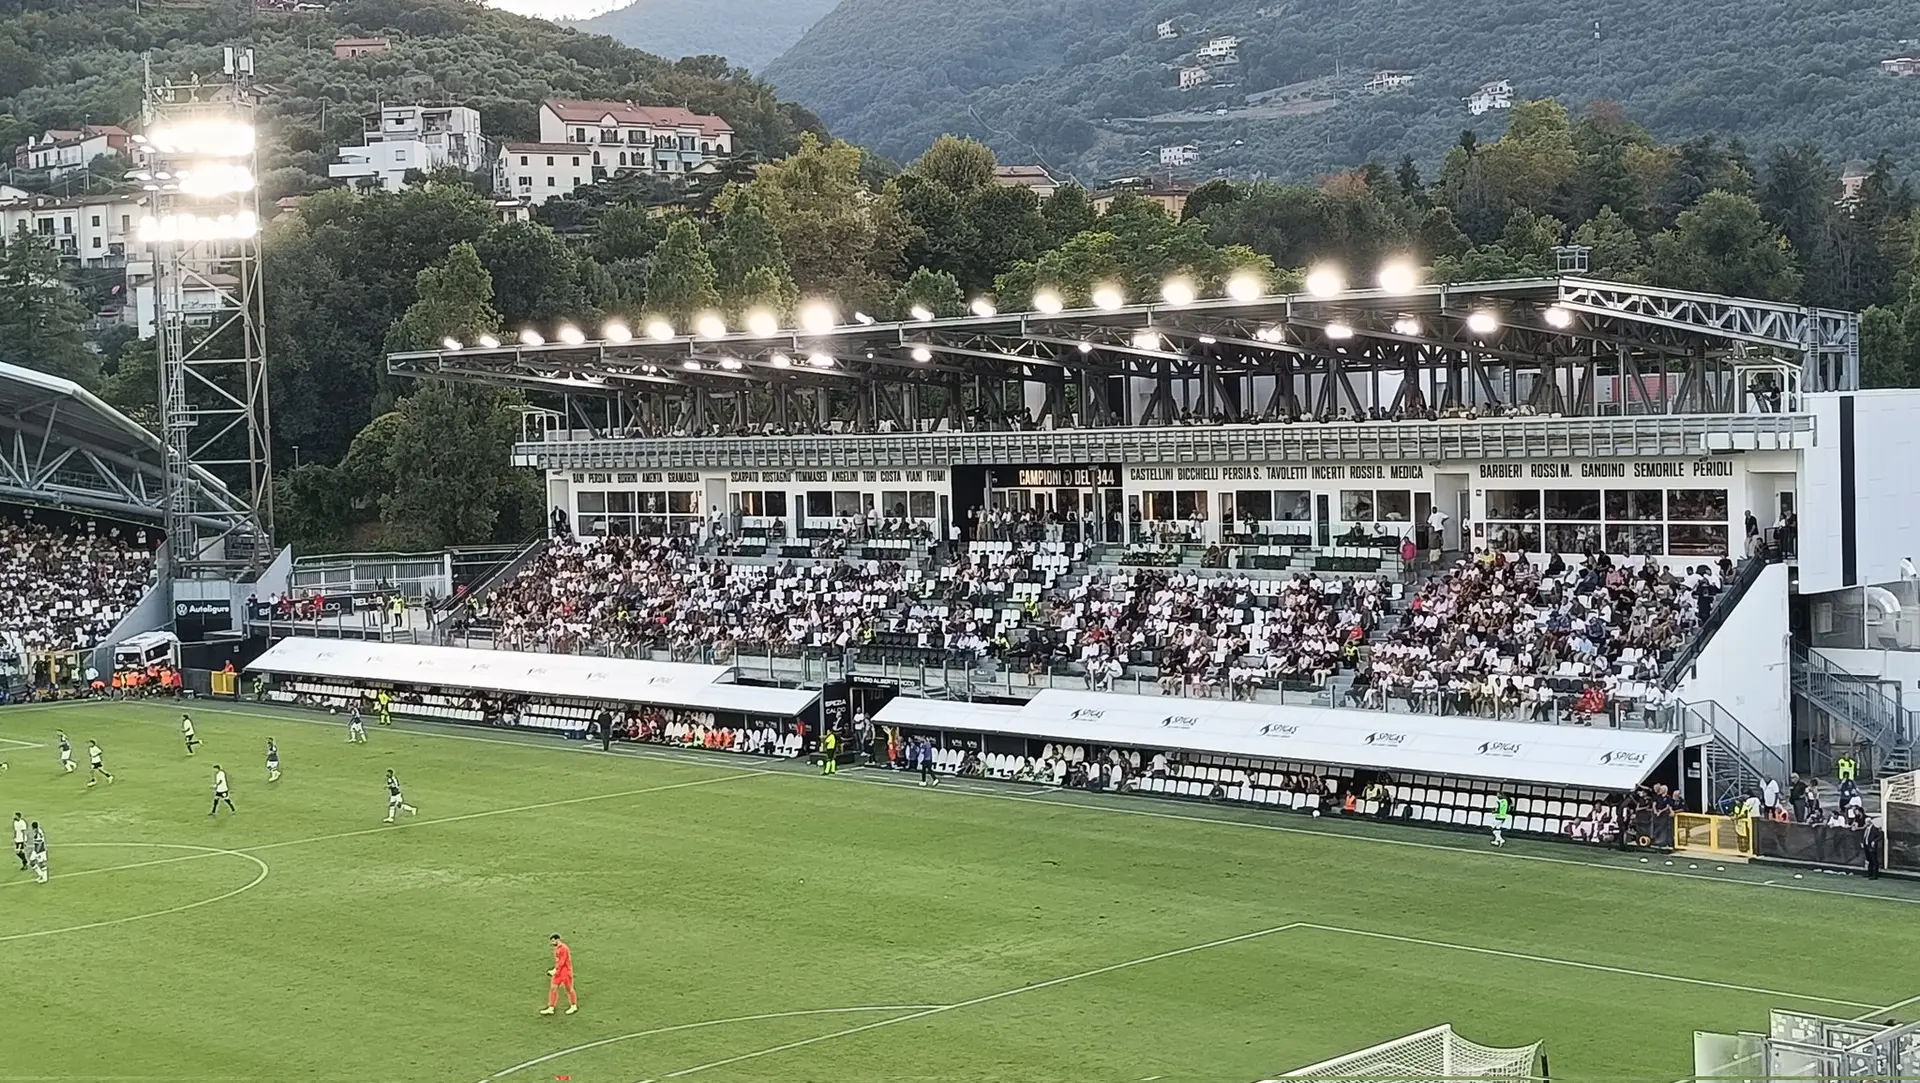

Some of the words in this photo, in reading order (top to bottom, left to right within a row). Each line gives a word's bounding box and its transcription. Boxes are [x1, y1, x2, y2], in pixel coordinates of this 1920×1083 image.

[1130, 467, 1174, 480] CASTELLINI
[1177, 467, 1218, 480] BICCHIELLI
[1222, 467, 1252, 480] PERSIA
[1253, 466, 1262, 480] S.
[1266, 466, 1307, 480] TAVOLETTI
[1311, 465, 1345, 480] INCERTI
[1349, 465, 1375, 479] ROSSI
[1376, 465, 1385, 479] B.
[1390, 465, 1424, 479] MEDICA
[1480, 464, 1523, 478] BARBIERI
[1530, 463, 1559, 478] ROSSI
[1560, 463, 1573, 478] M.
[1581, 463, 1625, 477] GANDINO
[1633, 462, 1685, 477] SEMORILE
[1693, 461, 1733, 477] PERIOLI
[730, 471, 759, 483] SCARPATO
[795, 471, 827, 482] TOMMASEO
[831, 471, 858, 482] ANGELINI
[862, 471, 877, 482] TORI
[880, 470, 901, 482] COSTA
[926, 470, 946, 482] FIUMI
[1019, 469, 1062, 486] CAMPIONI
[1074, 469, 1091, 485] DEL
[189, 603, 230, 615] Autoligure
[853, 676, 873, 684] STADIO
[873, 678, 898, 686] ALBERTO
[1376, 732, 1407, 743] SPIGAS
[1489, 742, 1522, 753] SPIGAS
[1613, 751, 1648, 763] SPIGAS
